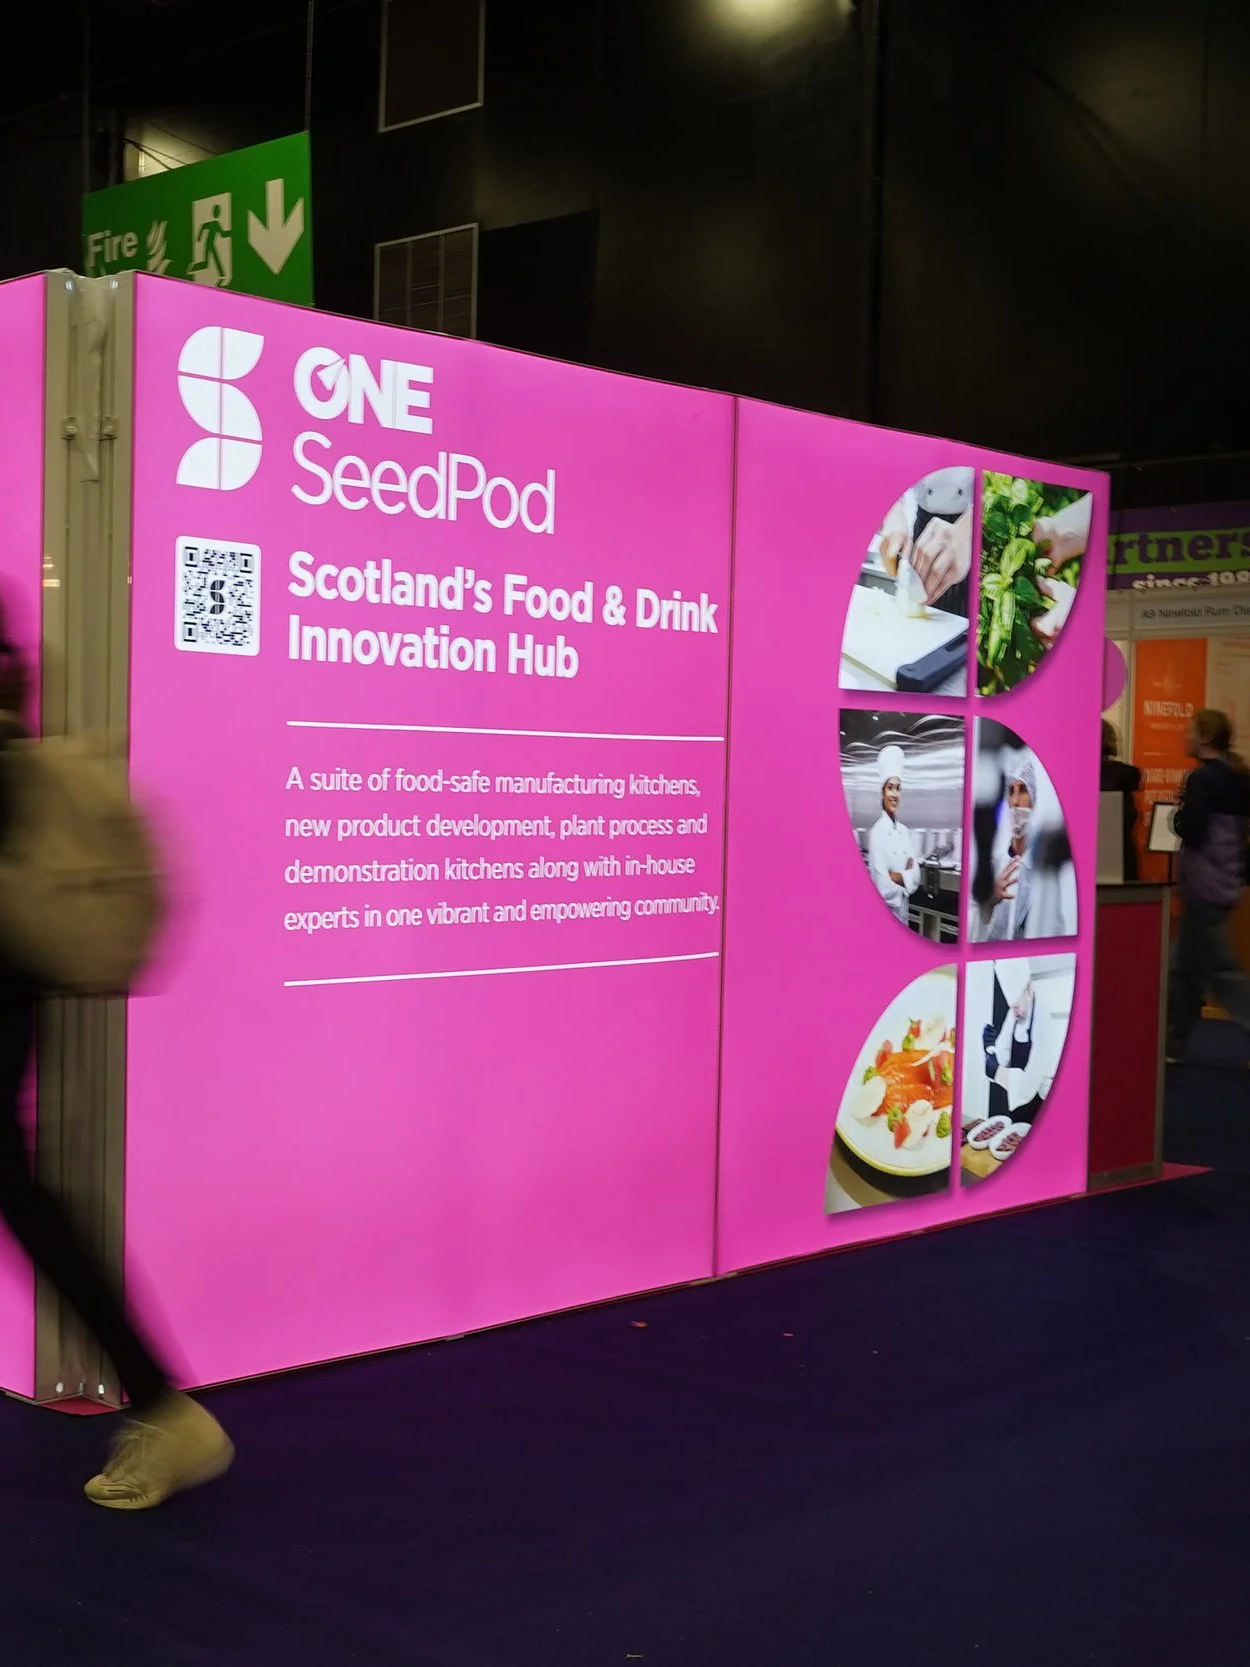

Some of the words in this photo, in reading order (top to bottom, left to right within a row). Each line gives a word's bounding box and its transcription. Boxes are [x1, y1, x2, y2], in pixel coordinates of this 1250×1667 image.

[86, 230, 139, 268] Fire
[293, 346, 433, 434] ONE
[291, 432, 555, 534] SeedPod
[288, 551, 492, 612] Scotland's
[504, 574, 593, 622] Food
[603, 586, 626, 625] &
[636, 589, 718, 633] Drink
[289, 615, 495, 672] Innovation
[509, 633, 578, 678] Hub
[286, 767, 304, 789] A
[310, 768, 362, 791] suite
[368, 768, 391, 791] of
[395, 768, 490, 792] food-safe
[496, 772, 625, 798] manufacturing
[629, 774, 700, 797] kitchens,
[286, 819, 331, 836] new
[338, 813, 421, 841] product
[426, 814, 555, 840] development,
[560, 815, 605, 840] plant
[609, 819, 673, 839] process
[677, 814, 707, 834] and
[285, 859, 439, 883] demonstration
[445, 858, 524, 880] kitchens
[528, 857, 578, 881] along
[583, 855, 620, 876] with
[625, 855, 695, 875] in-house
[284, 907, 359, 934] experts
[365, 905, 381, 927] in
[386, 909, 422, 926] one
[427, 902, 490, 924] vibrant
[494, 900, 526, 922] and
[530, 897, 631, 923] empowering
[634, 892, 719, 915] community.
